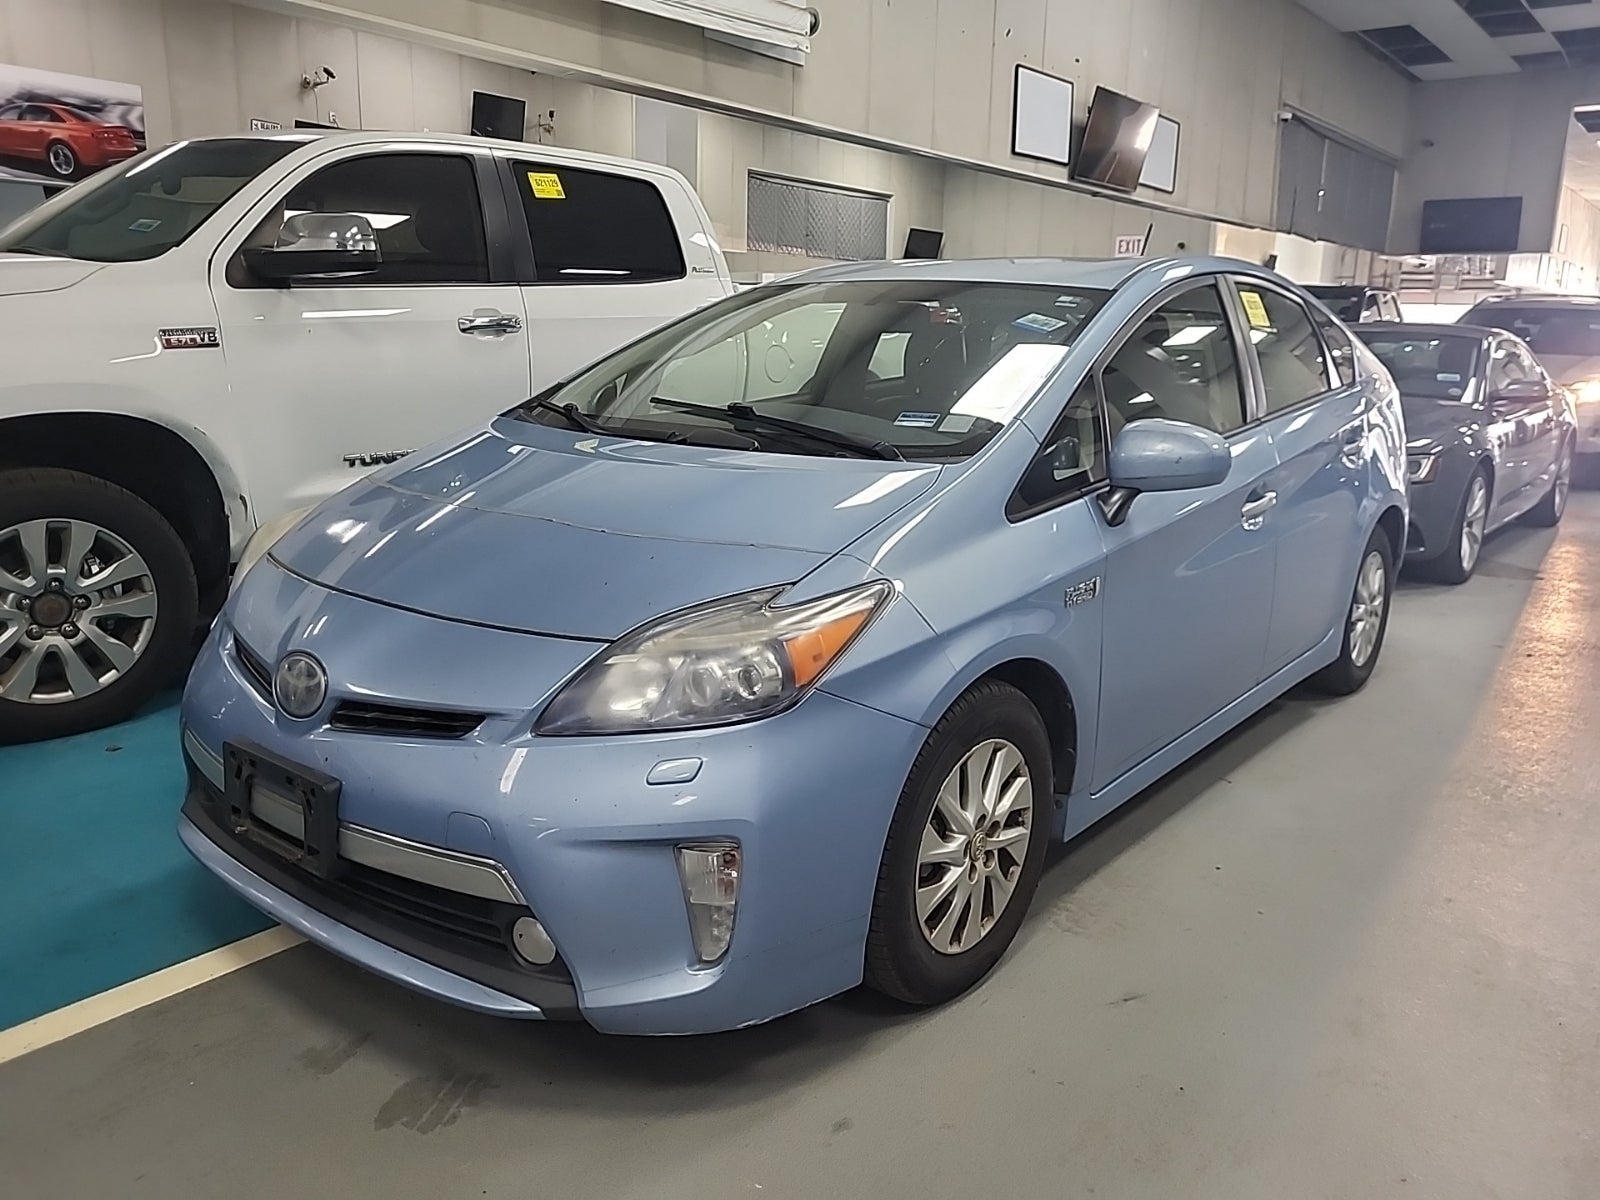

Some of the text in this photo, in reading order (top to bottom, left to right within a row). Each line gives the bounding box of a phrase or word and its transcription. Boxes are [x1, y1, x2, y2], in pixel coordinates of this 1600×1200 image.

[535, 178, 559, 188] 621129
[1118, 239, 1142, 254] EXIT
[198, 330, 218, 343] V8
